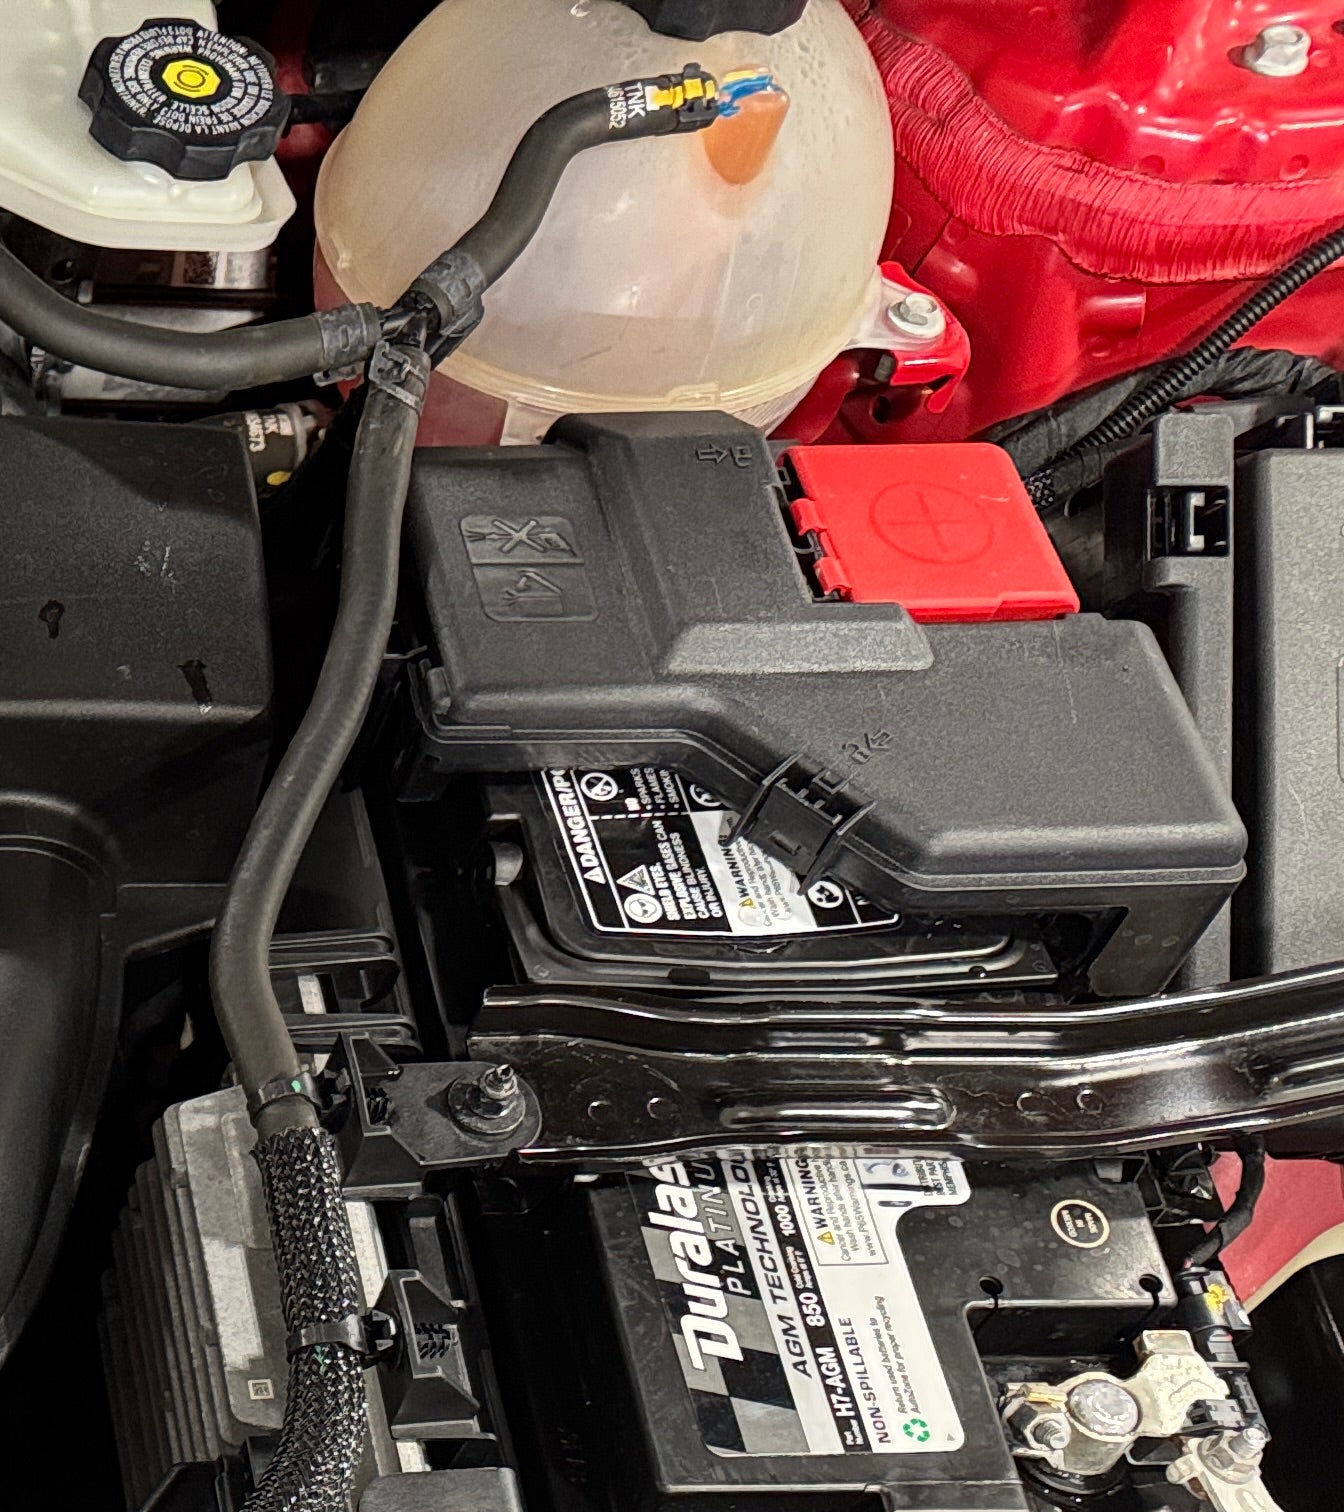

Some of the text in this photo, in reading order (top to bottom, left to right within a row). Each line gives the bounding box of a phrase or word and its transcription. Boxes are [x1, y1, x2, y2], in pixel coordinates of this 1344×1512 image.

[624, 82, 645, 119] TNK
[630, 768, 652, 805] SPARKS
[644, 767, 663, 803] FLAMES
[651, 820, 697, 920] EXPLOSIVE GASES CAN
[669, 832, 710, 919] CAUSE BLINDNESS
[658, 889, 681, 921] SHIELD
[707, 902, 724, 918] OR
[832, 1184, 844, 1202] after
[839, 1160, 876, 1256] www.P65Warnings.ca
[775, 1204, 796, 1236] 1000
[813, 1164, 851, 1261] Cancer and Reproductive
[840, 1203, 853, 1228] hands
[847, 1229, 860, 1252] Wash
[799, 1292, 826, 1327] 850
[776, 1314, 812, 1378] AGM
[874, 1295, 921, 1414] AutoZone for proper recycling
[815, 1346, 856, 1417] H7-AGM
[838, 1317, 891, 1444] NON-SPILLABLE
[869, 1317, 907, 1414] Return used batteries to
